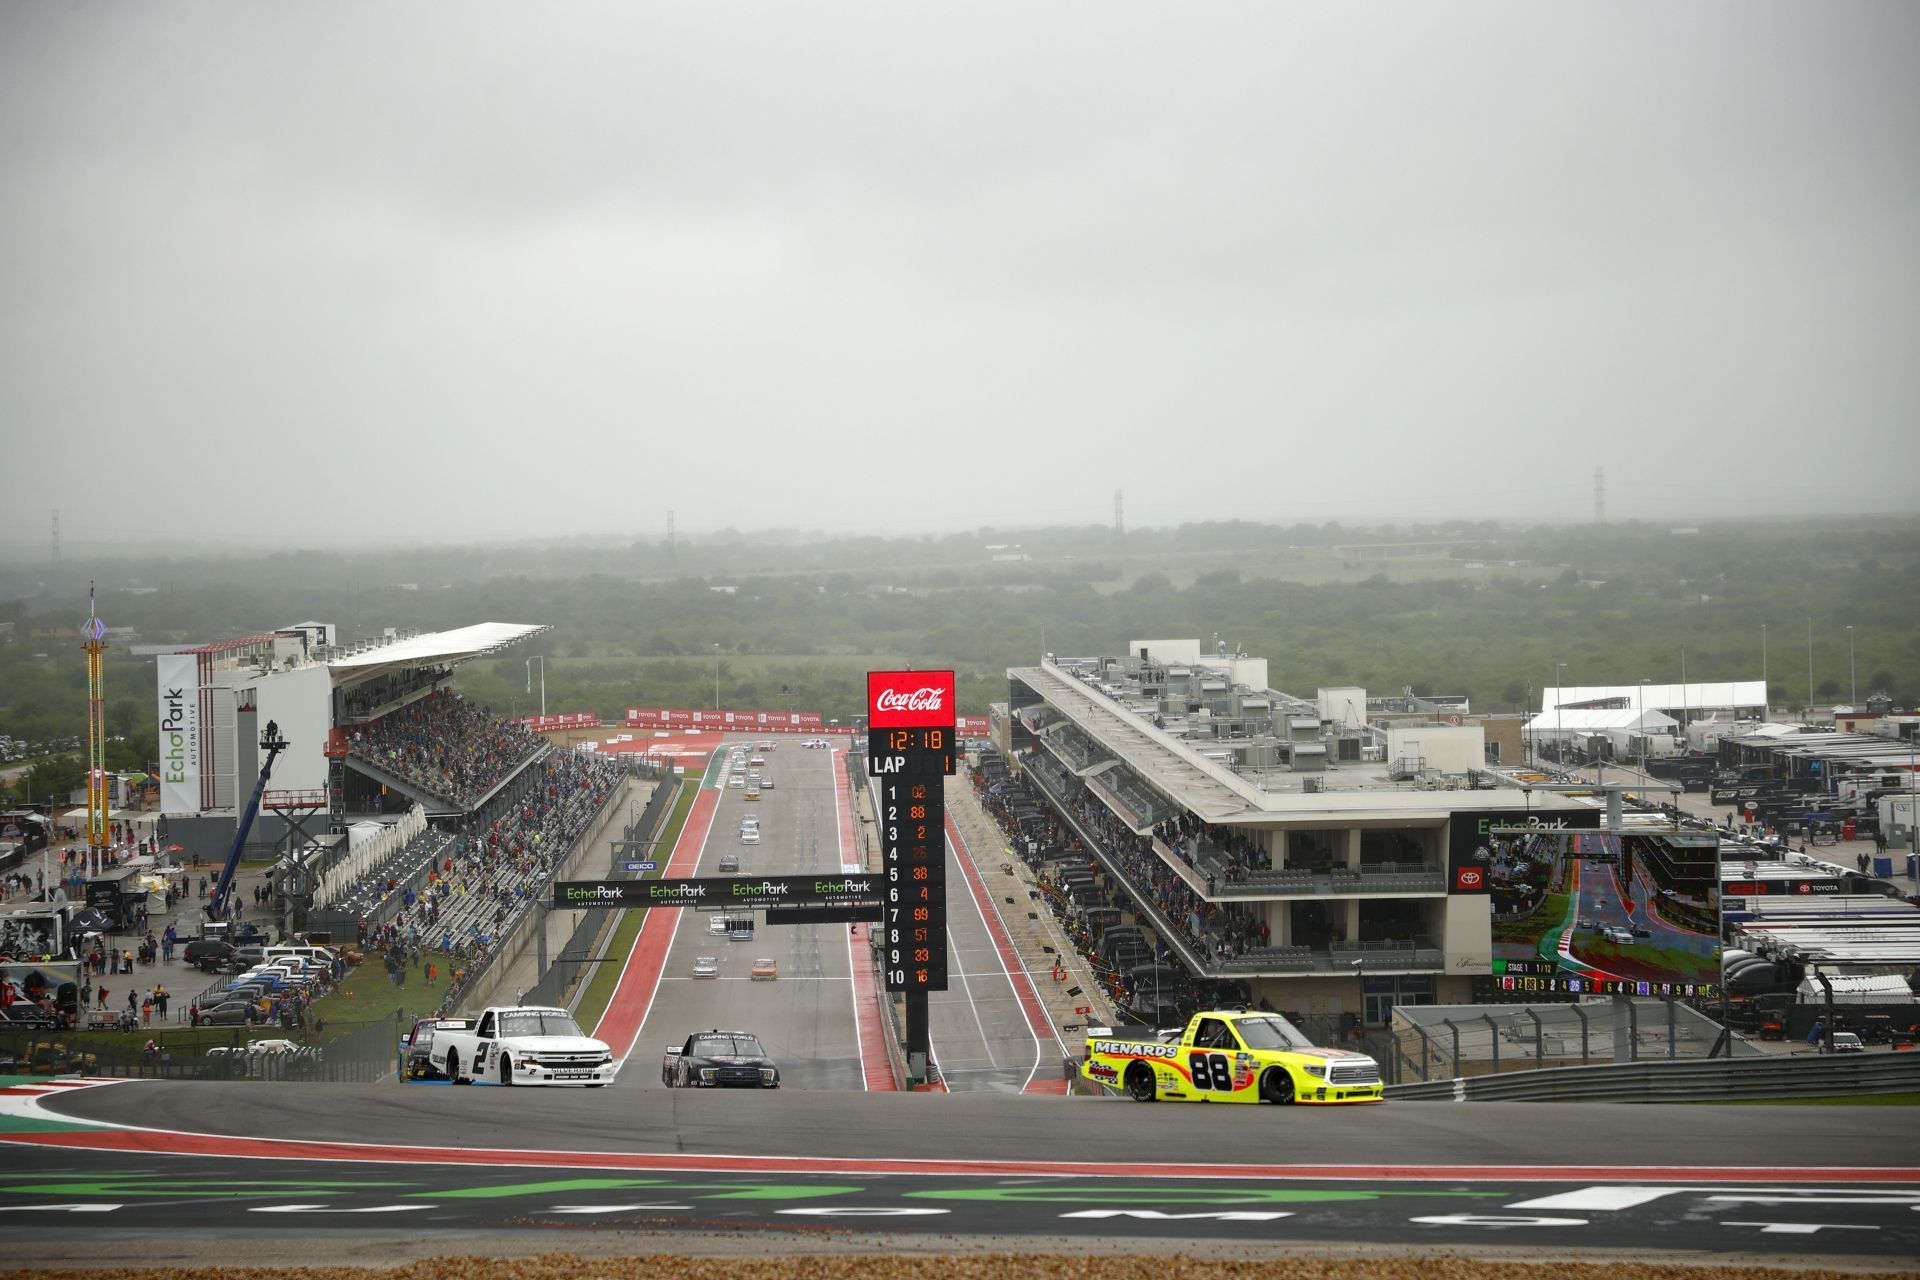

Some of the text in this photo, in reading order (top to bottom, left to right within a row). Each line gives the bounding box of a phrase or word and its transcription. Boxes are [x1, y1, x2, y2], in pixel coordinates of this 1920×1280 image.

[877, 688, 946, 711] Coca-Cola
[162, 688, 184, 784] EchoPark
[890, 731, 942, 750] 12:18
[874, 757, 905, 773] LAP
[889, 786, 896, 800] 1
[889, 806, 925, 820] 2 88
[889, 826, 925, 840] 3 2
[890, 847, 897, 860] 4
[890, 867, 928, 881] 5 38
[567, 886, 623, 899] EchoPark
[651, 884, 705, 897] EchoPark
[733, 882, 788, 895] EchoPark
[815, 880, 871, 893] EchoPark
[890, 887, 928, 902] 6 4
[890, 908, 928, 922] 7 99
[891, 929, 899, 942] 8
[892, 950, 899, 963] 9
[1508, 964, 1523, 972] STAGE
[888, 970, 904, 984] 10
[1496, 979, 1500, 987] 1
[1518, 980, 1522, 988] 2
[1540, 980, 1544, 989] 3
[1550, 980, 1555, 990] 2
[1562, 981, 1566, 990] 4
[1570, 980, 1580, 991] 26
[1584, 982, 1589, 991] 5
[1607, 982, 1611, 992] 6
[1618, 982, 1623, 993] 4
[1630, 984, 1634, 993] 7
[1676, 985, 1680, 994] 9
[1685, 984, 1693, 996] 16
[1698, 986, 1705, 996] 10
[1094, 1041, 1177, 1058] MENARDS
[472, 1042, 490, 1074] 2
[1189, 1052, 1233, 1092] 88
